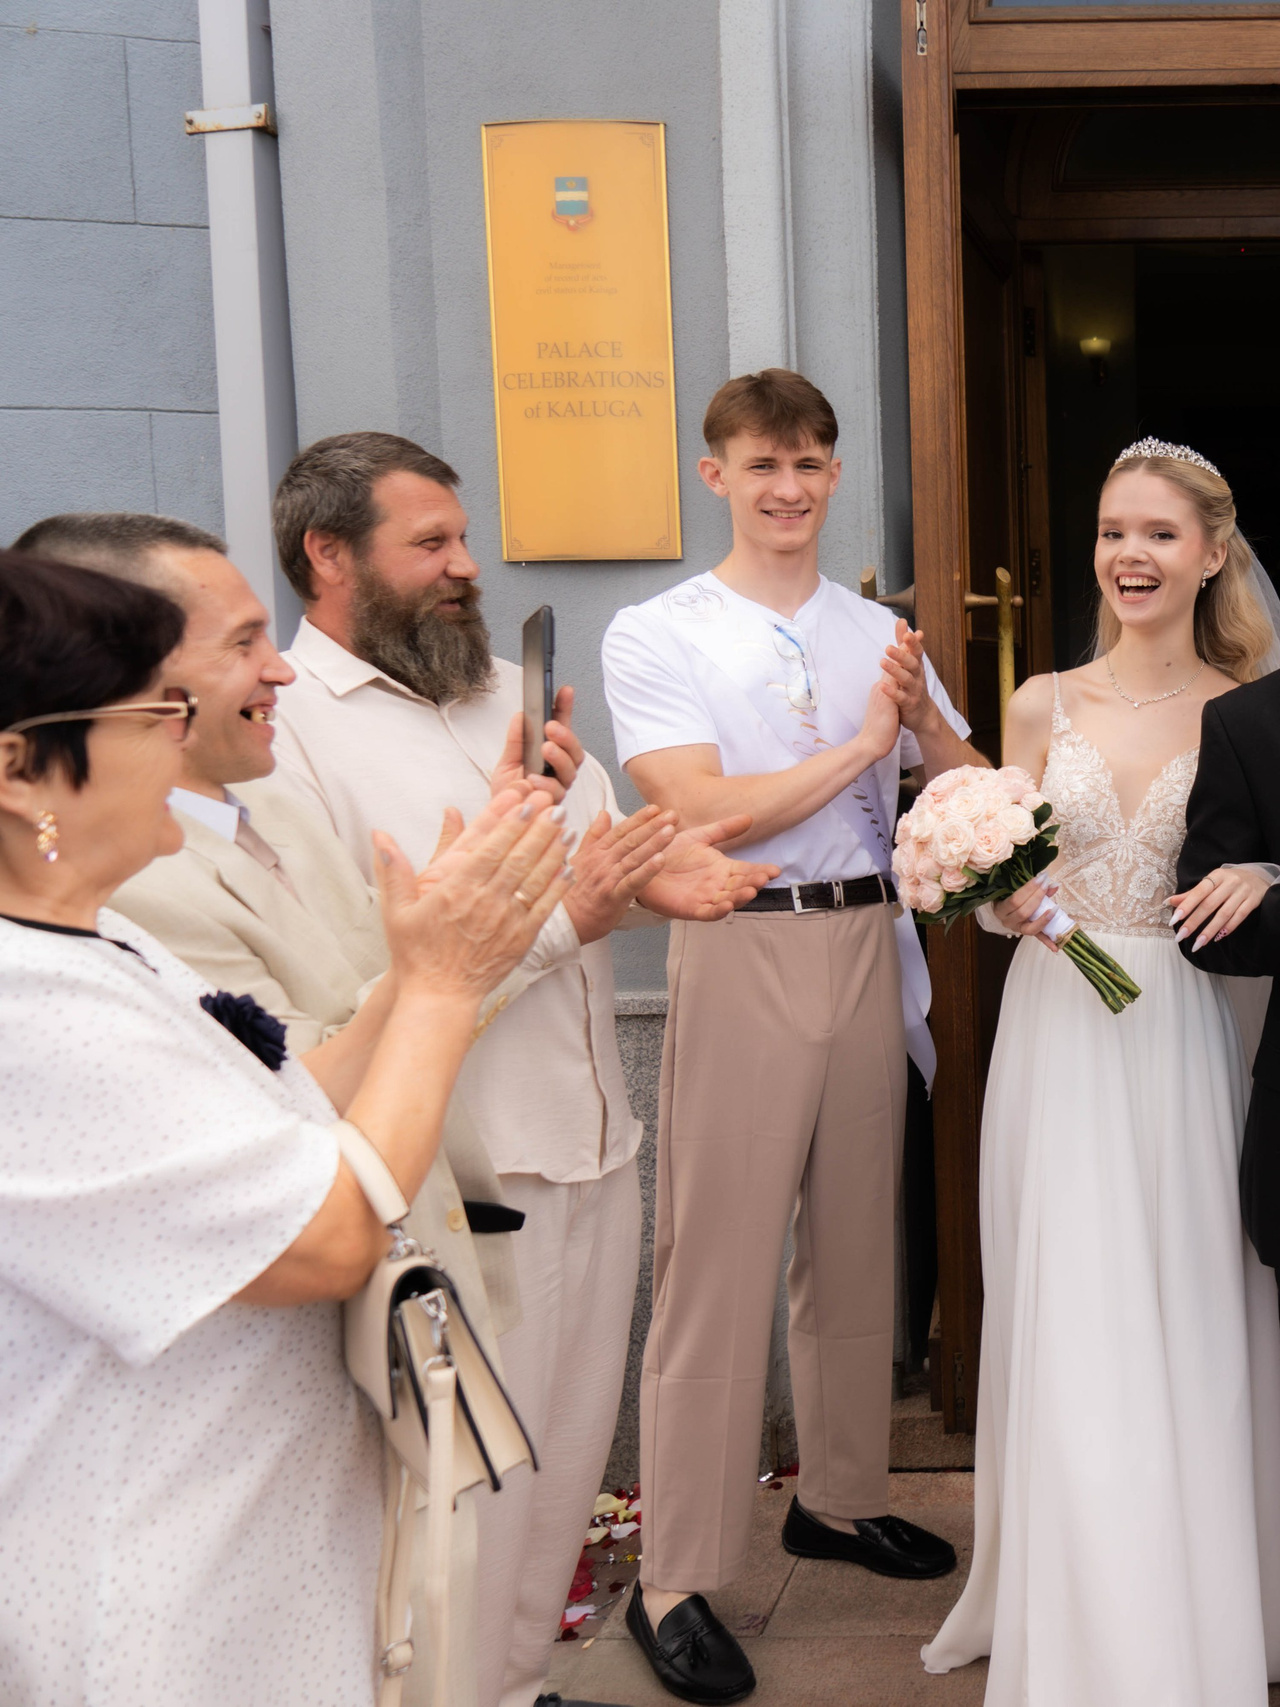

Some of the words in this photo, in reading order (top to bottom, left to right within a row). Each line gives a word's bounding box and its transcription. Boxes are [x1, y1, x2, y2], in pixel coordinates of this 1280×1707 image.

[536, 341, 623, 359] PALACE
[502, 370, 665, 391] CELEBRATIONS
[524, 401, 543, 419] of
[547, 400, 643, 418] KALUGA
